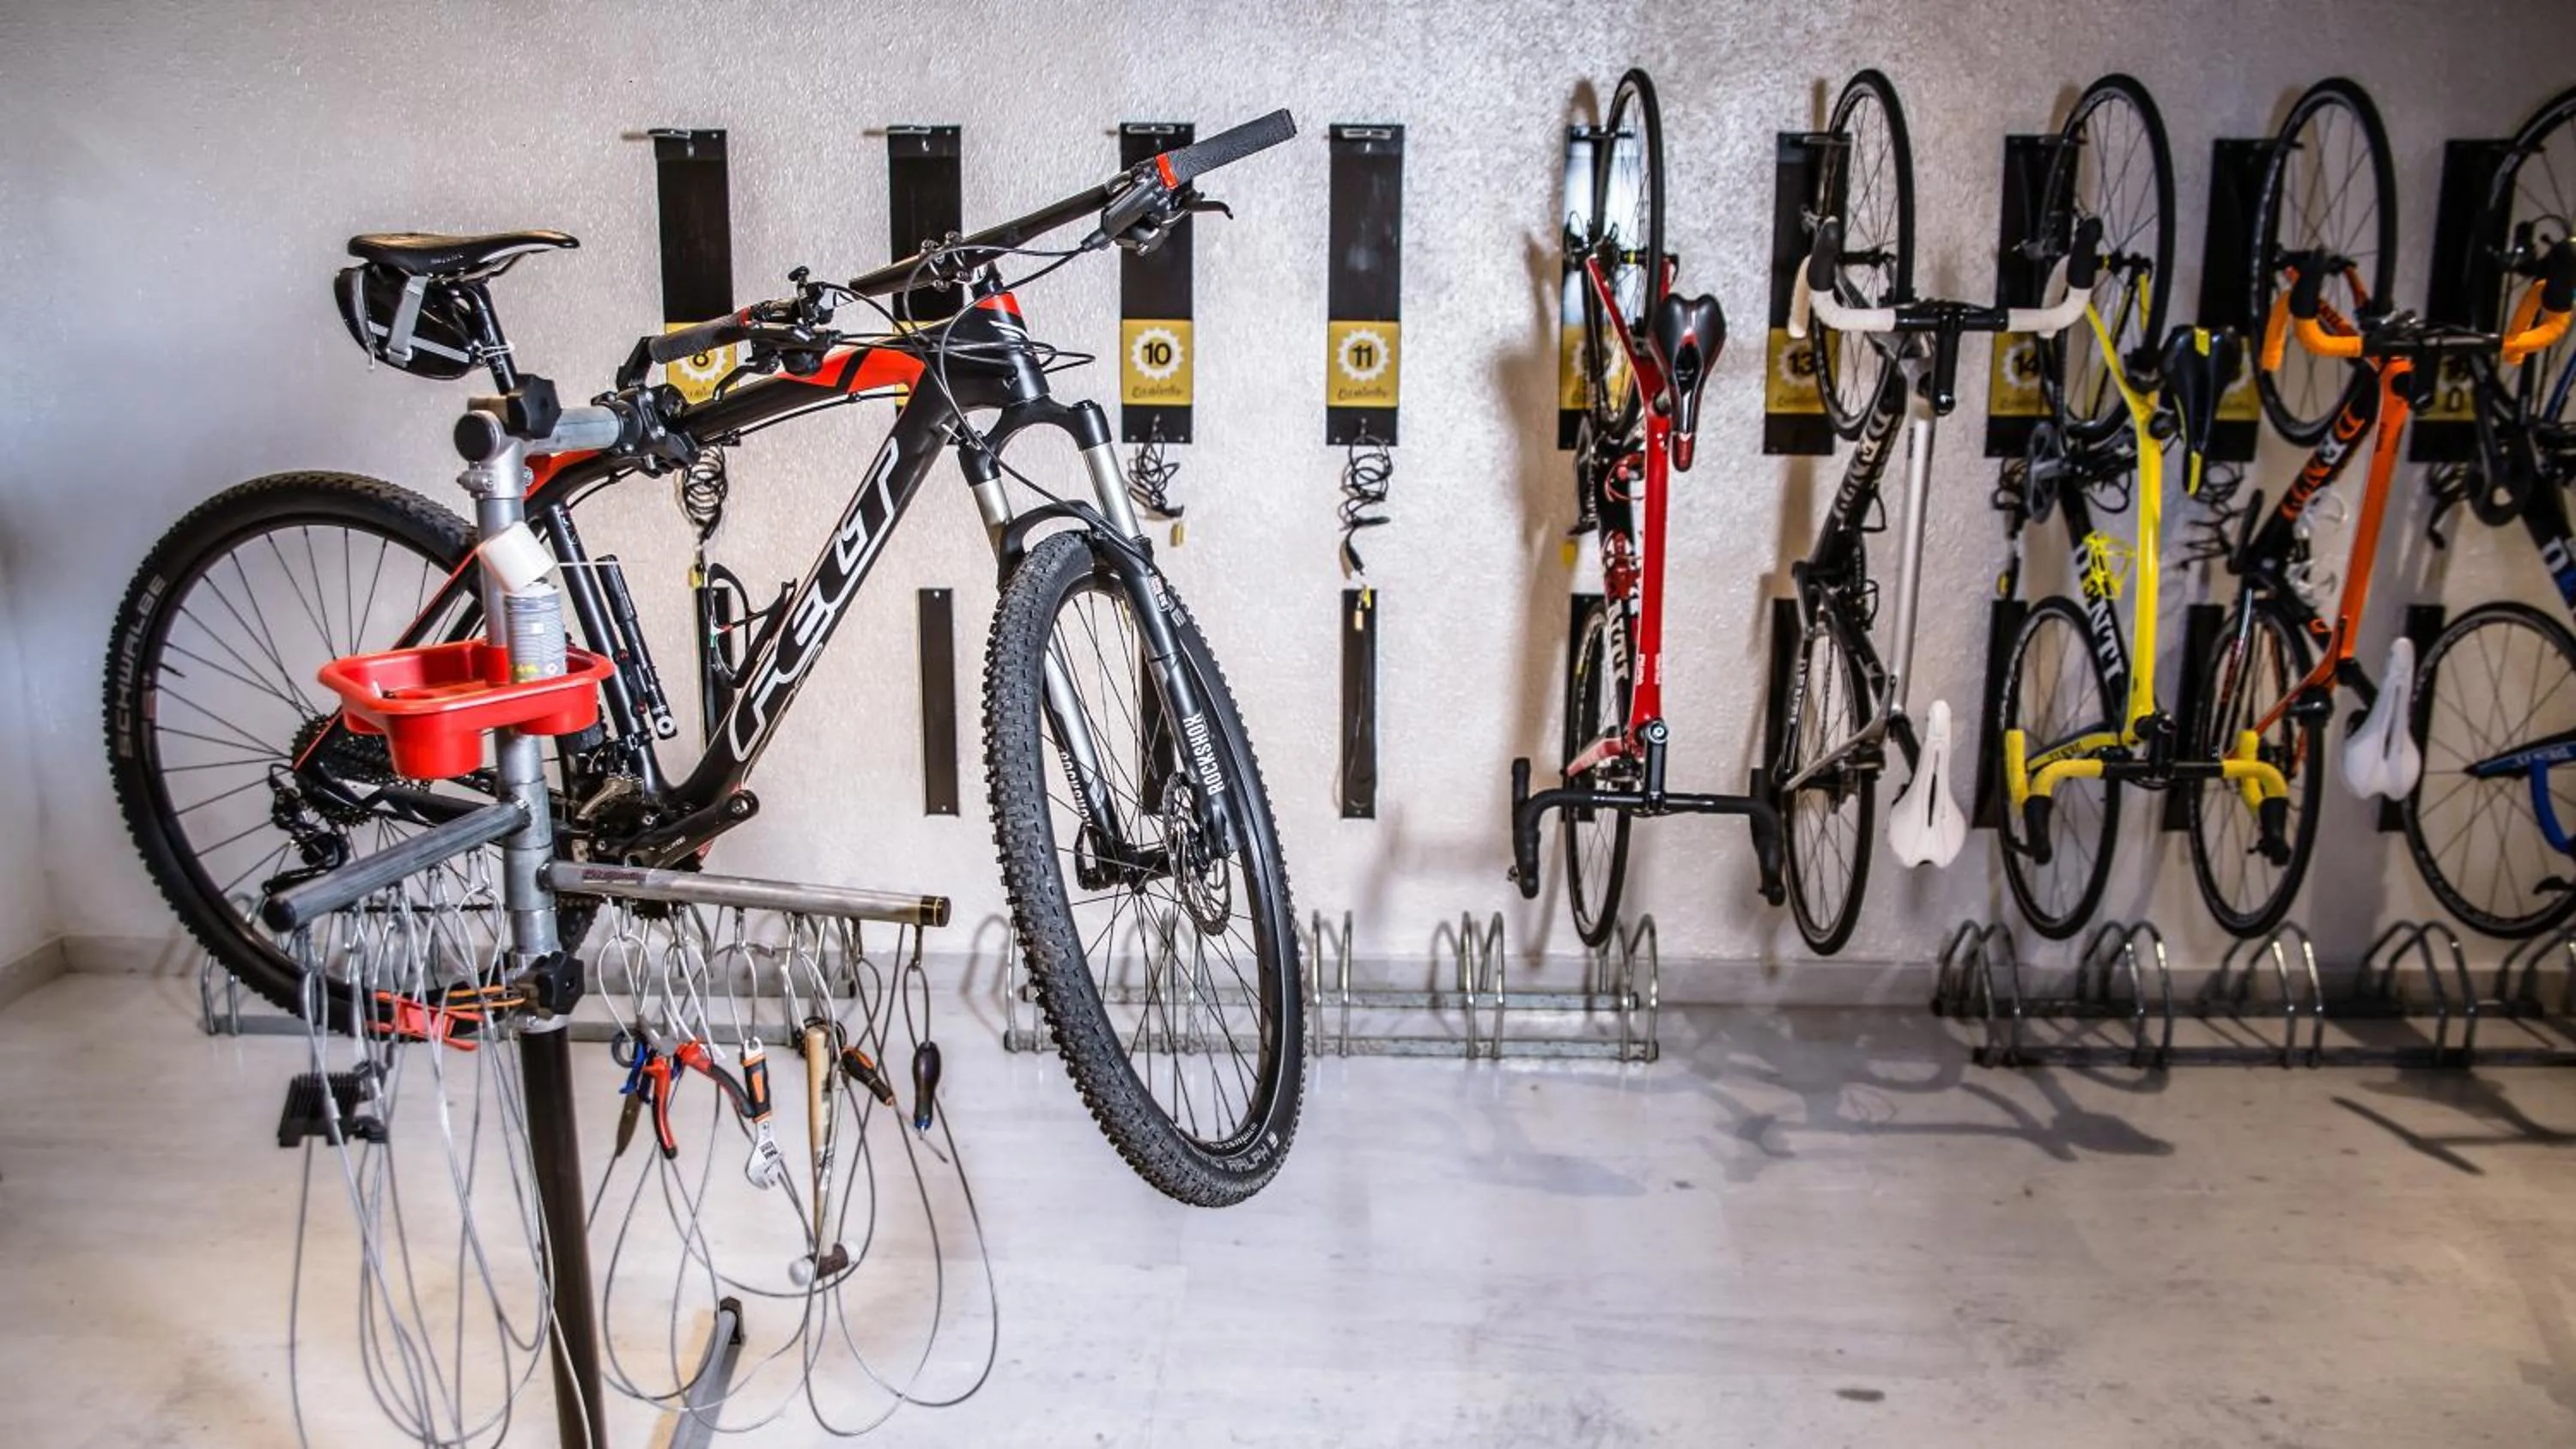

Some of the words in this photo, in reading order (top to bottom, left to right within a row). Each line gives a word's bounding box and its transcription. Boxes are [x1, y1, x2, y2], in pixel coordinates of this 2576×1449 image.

[1142, 342, 1172, 366] 10
[1352, 344, 1372, 368] 11
[1787, 350, 1817, 376] 13
[729, 436, 900, 761] FELT
[115, 573, 167, 759] SCHWALBE
[1182, 712, 1225, 797] ROCKSHOX
